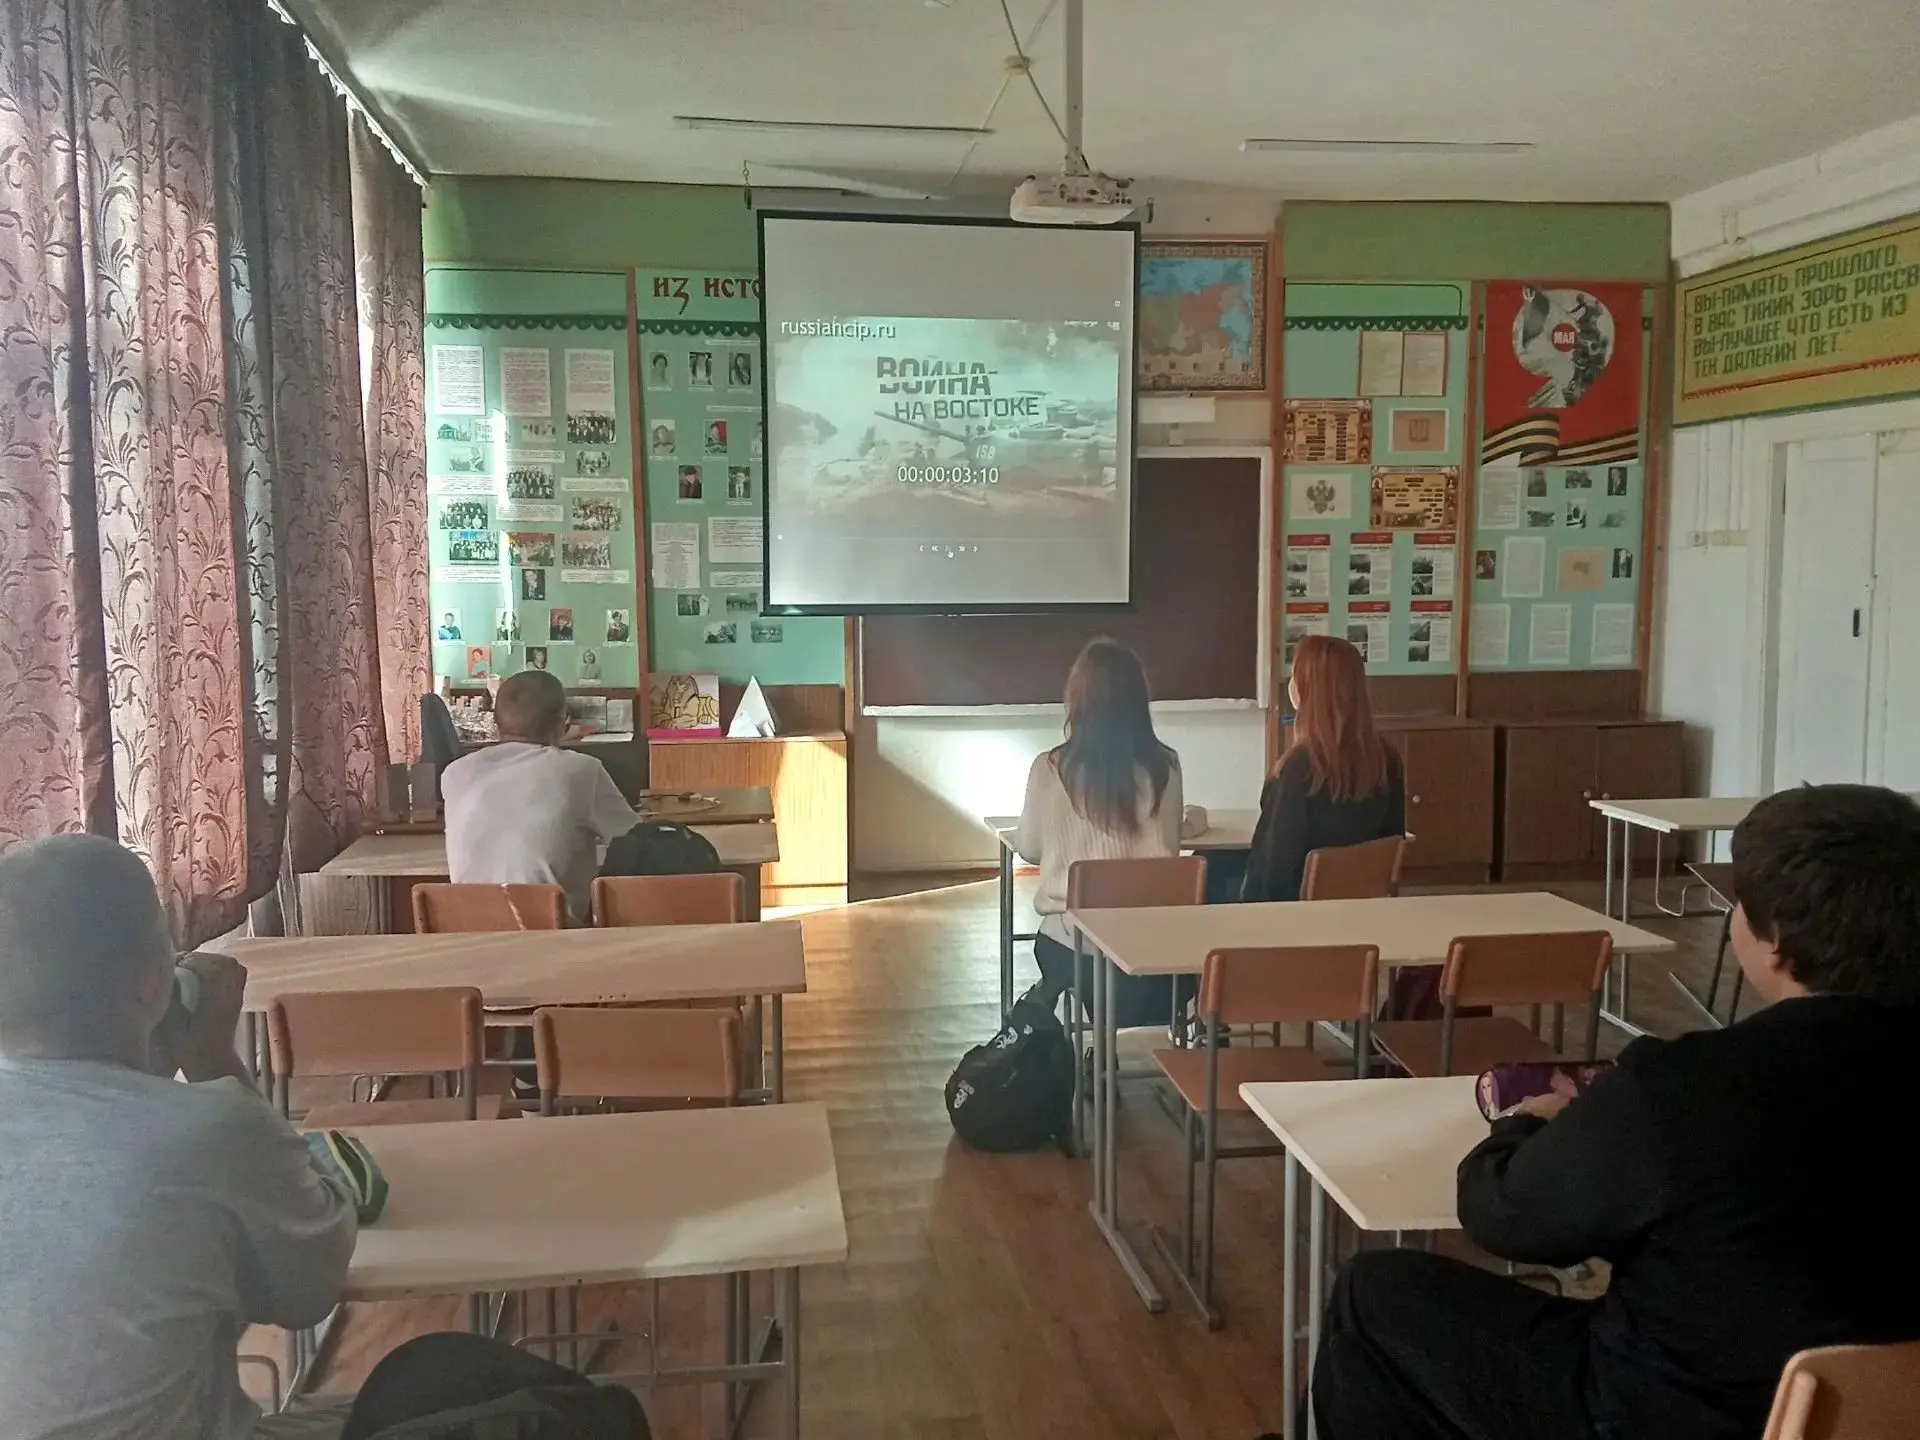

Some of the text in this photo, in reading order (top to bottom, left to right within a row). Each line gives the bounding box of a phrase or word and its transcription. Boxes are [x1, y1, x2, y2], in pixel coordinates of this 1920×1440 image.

[653, 276, 690, 315] ИЗ
[1694, 317, 1703, 336] В
[1708, 308, 1736, 333] ВАС
[1801, 283, 1847, 311] ЗОРЬ
[1787, 312, 1820, 336] ЧТО
[1828, 301, 1873, 329] ЕСТЬ
[1881, 293, 1907, 318] ИЗ
[1553, 331, 1575, 345] МАЯ
[895, 397, 1039, 420] НА ВОСТОКЕ
[897, 466, 999, 484] 00:00:03:10
